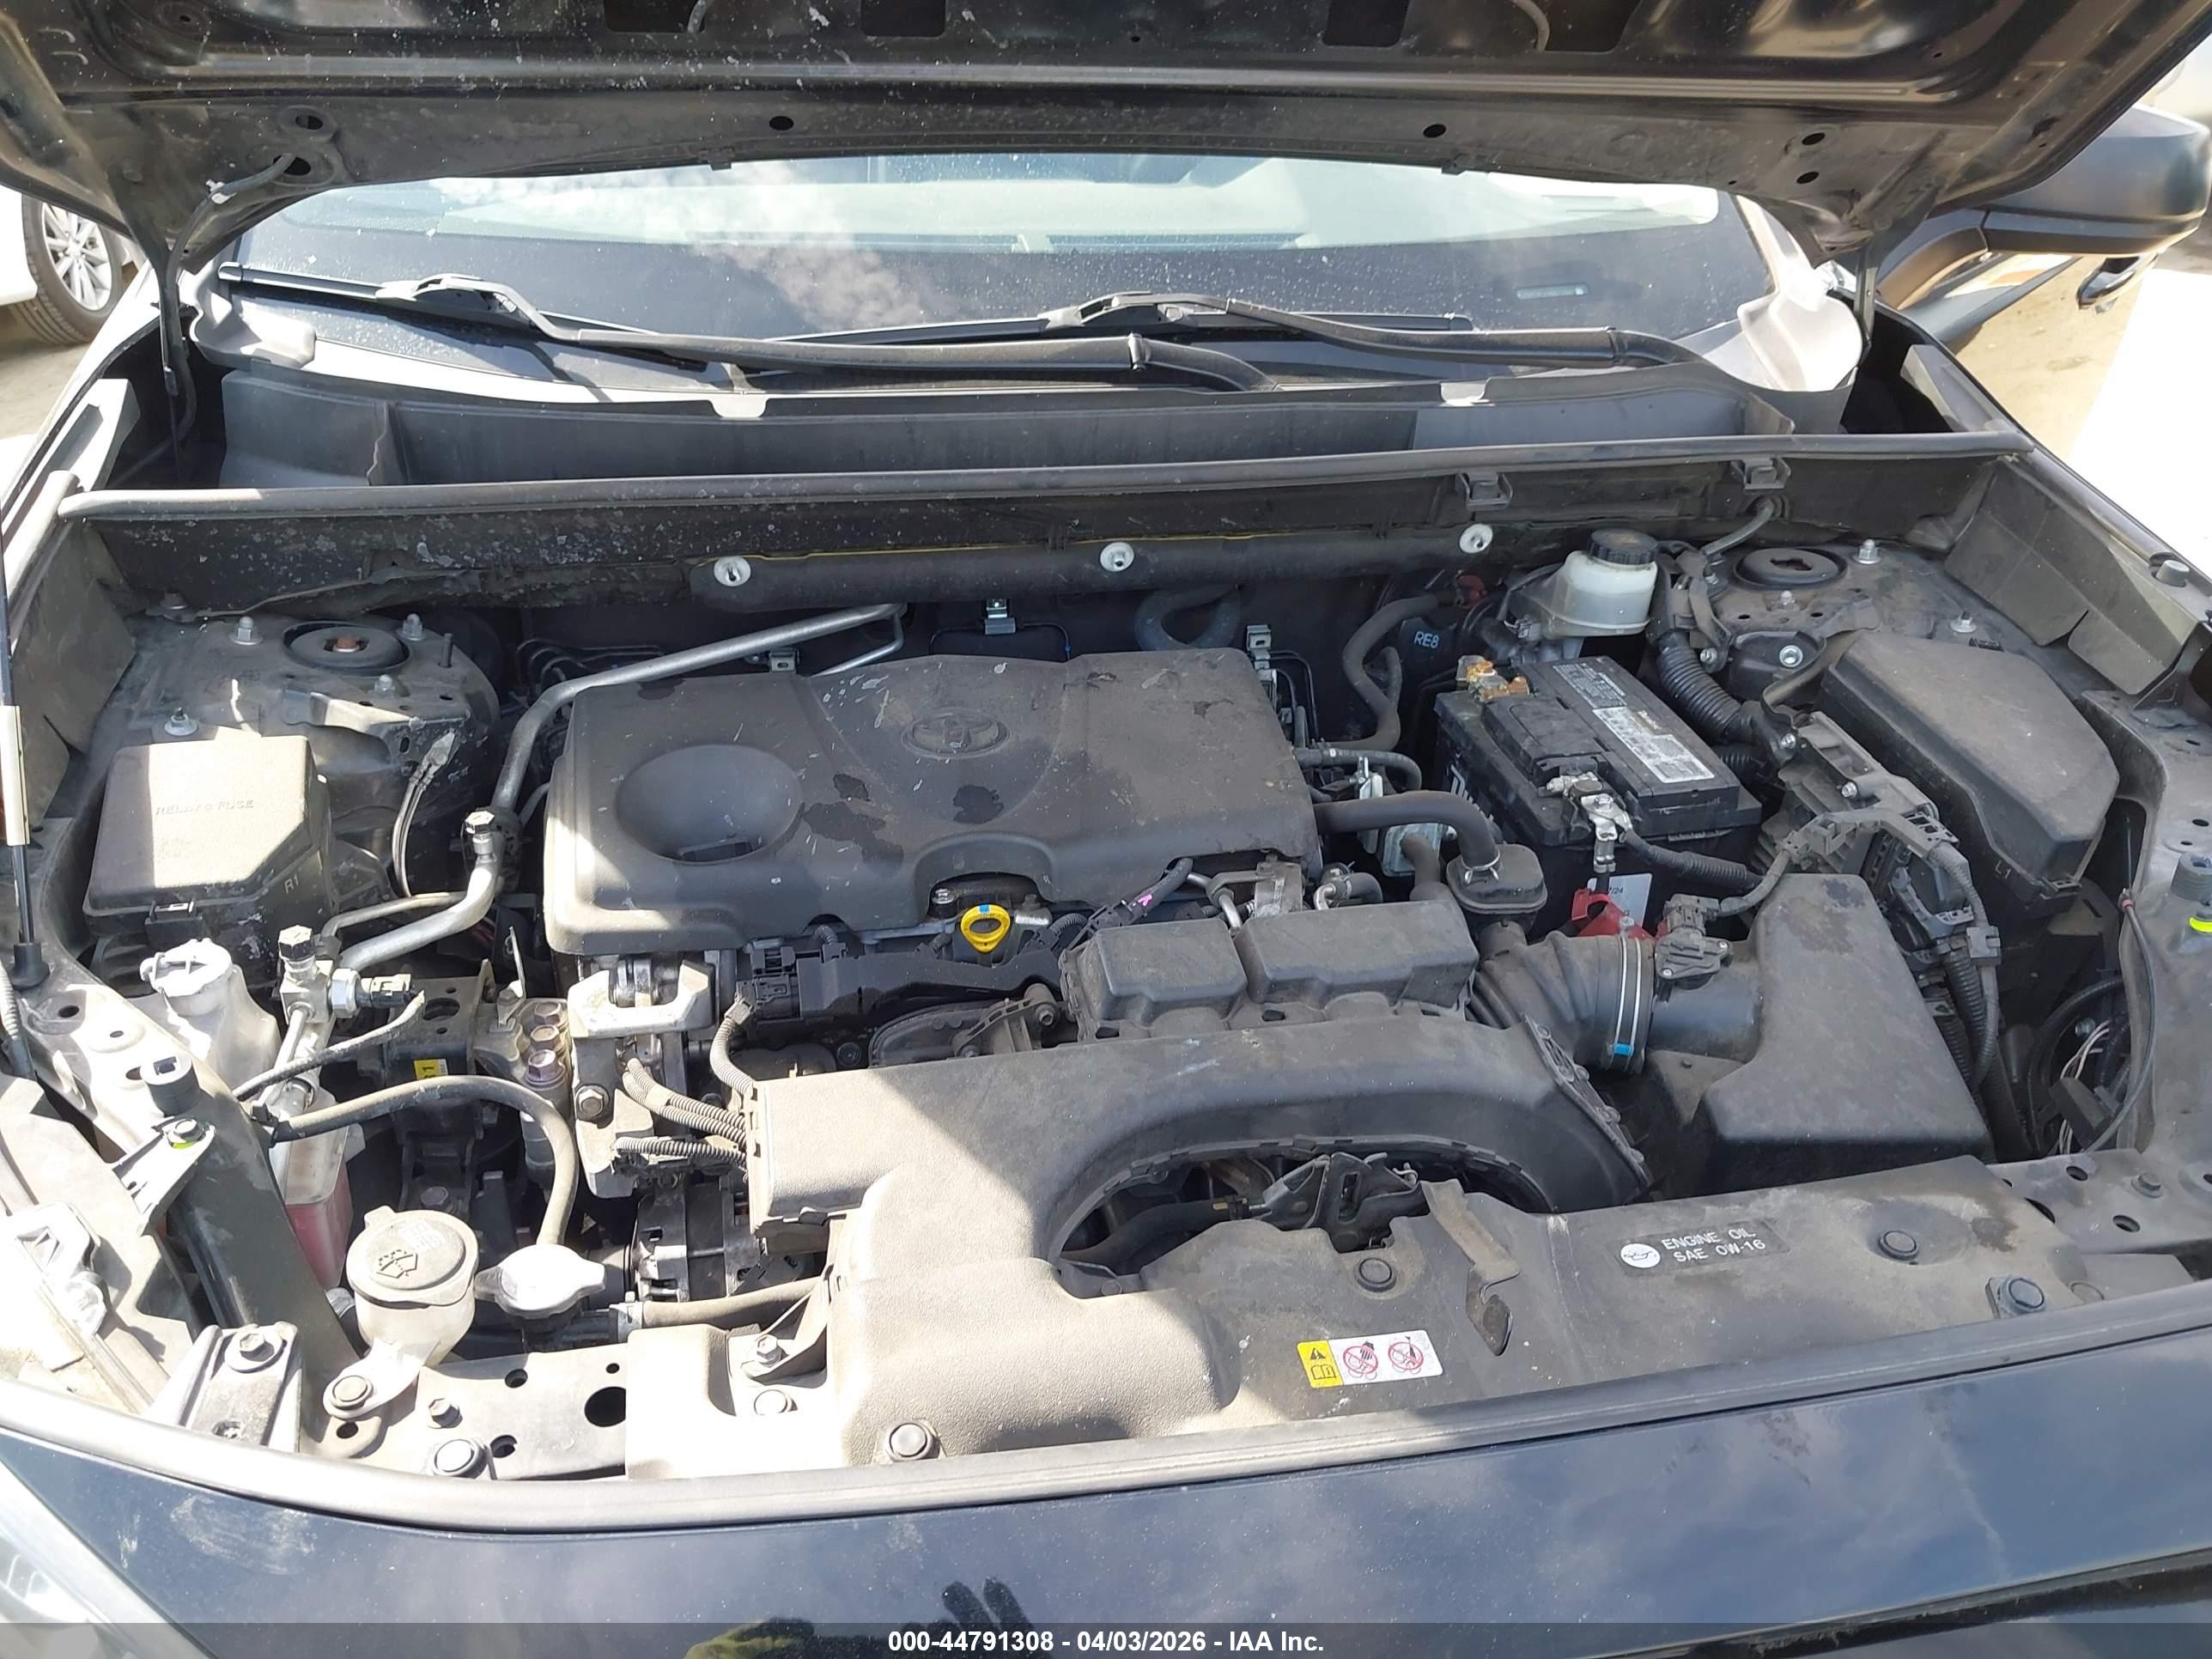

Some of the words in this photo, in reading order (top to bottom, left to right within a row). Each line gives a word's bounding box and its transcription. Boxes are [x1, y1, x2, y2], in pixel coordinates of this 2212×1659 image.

[1414, 631, 1439, 649] RE8
[217, 799, 255, 811] FUSE
[1995, 860, 2012, 879] L1
[284, 873, 299, 894] R1
[1662, 1231, 1721, 1249] ENGINE
[1729, 1227, 1757, 1240] OIL
[1673, 1247, 1709, 1262] SAE
